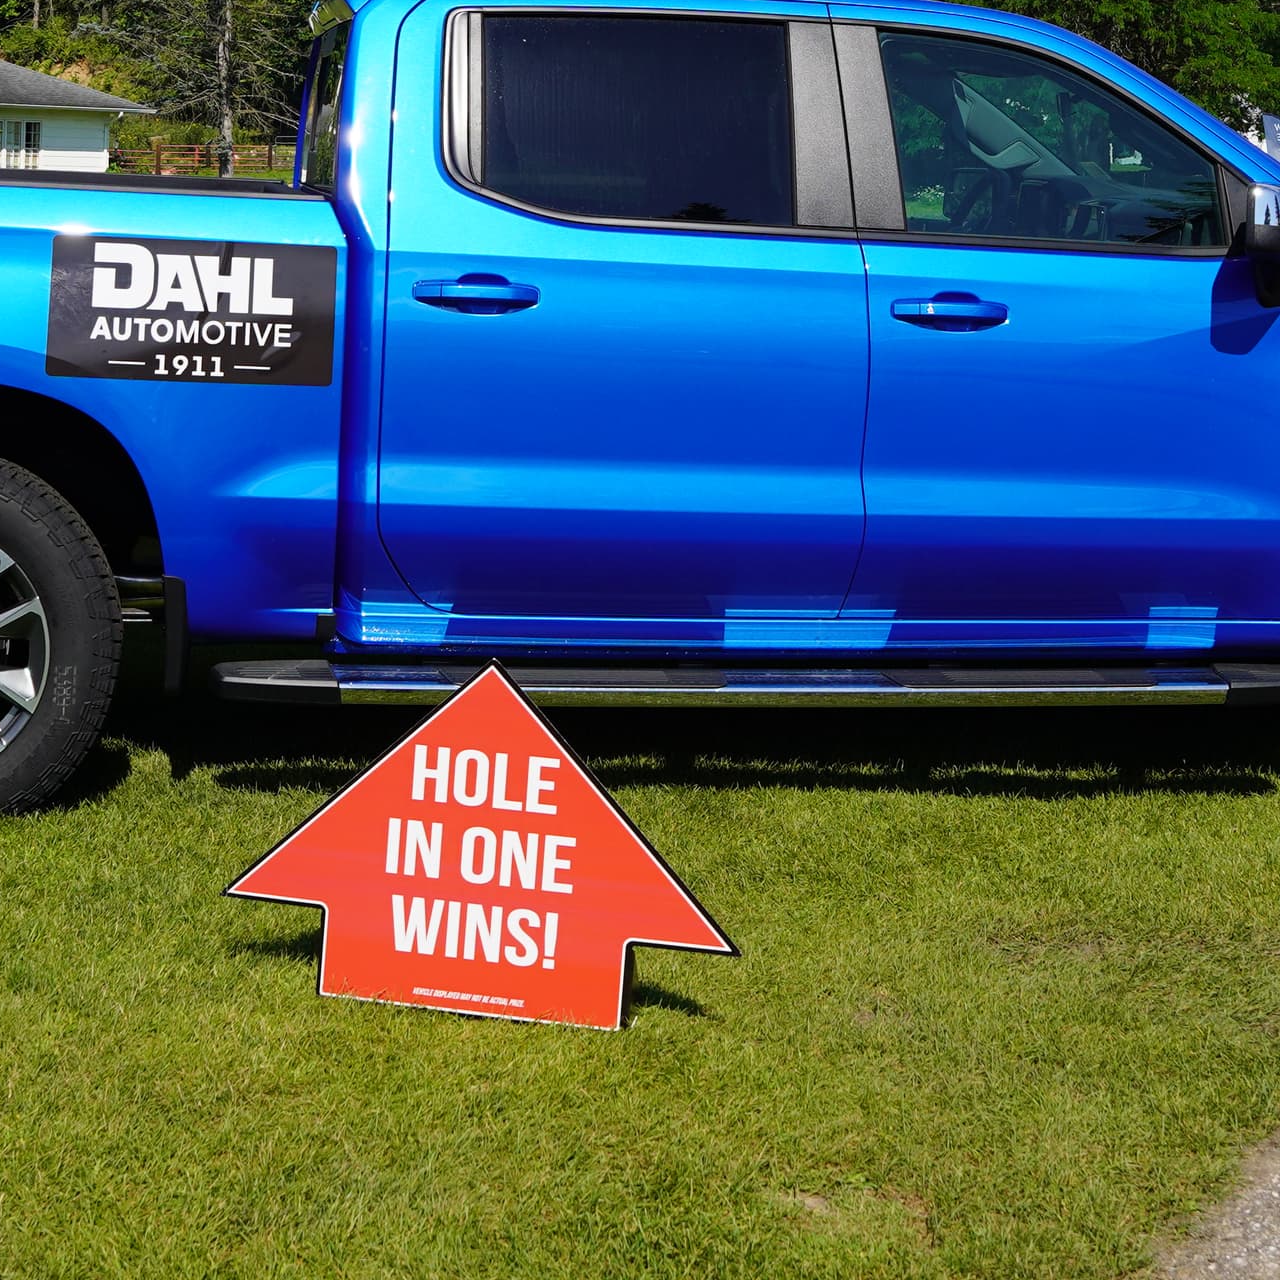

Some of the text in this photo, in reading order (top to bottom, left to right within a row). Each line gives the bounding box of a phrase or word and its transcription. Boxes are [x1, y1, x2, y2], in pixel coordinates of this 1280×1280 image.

[91, 242, 294, 316] DAHL
[89, 316, 293, 348] AUTOMOTIVE
[154, 354, 225, 377] 1911
[411, 744, 561, 815] HOLE
[385, 817, 577, 894] IN ONE
[391, 894, 559, 970] WINS!
